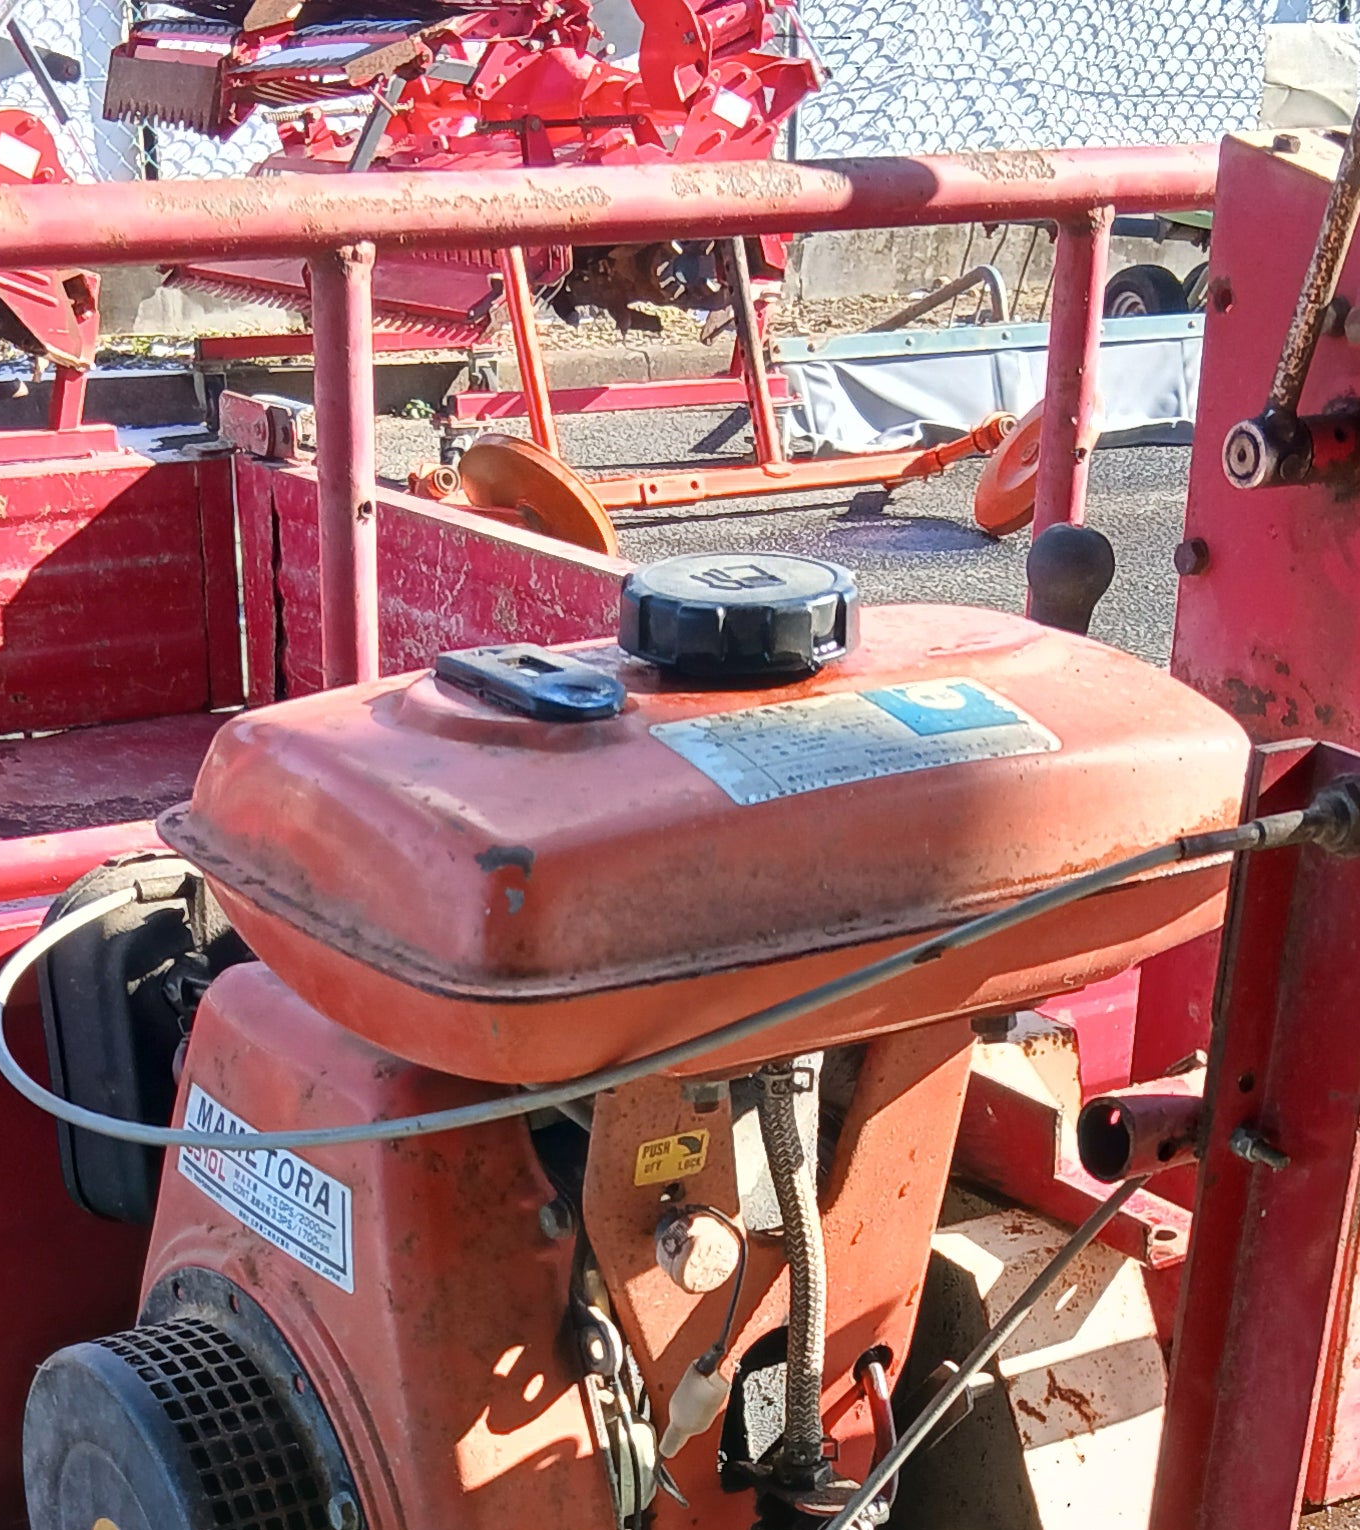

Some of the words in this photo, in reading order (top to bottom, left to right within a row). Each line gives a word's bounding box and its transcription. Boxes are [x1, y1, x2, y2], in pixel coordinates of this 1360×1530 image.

[642, 1140, 671, 1160] PUSH
[186, 1146, 226, 1182] 510L
[678, 1156, 702, 1171] LOCK
